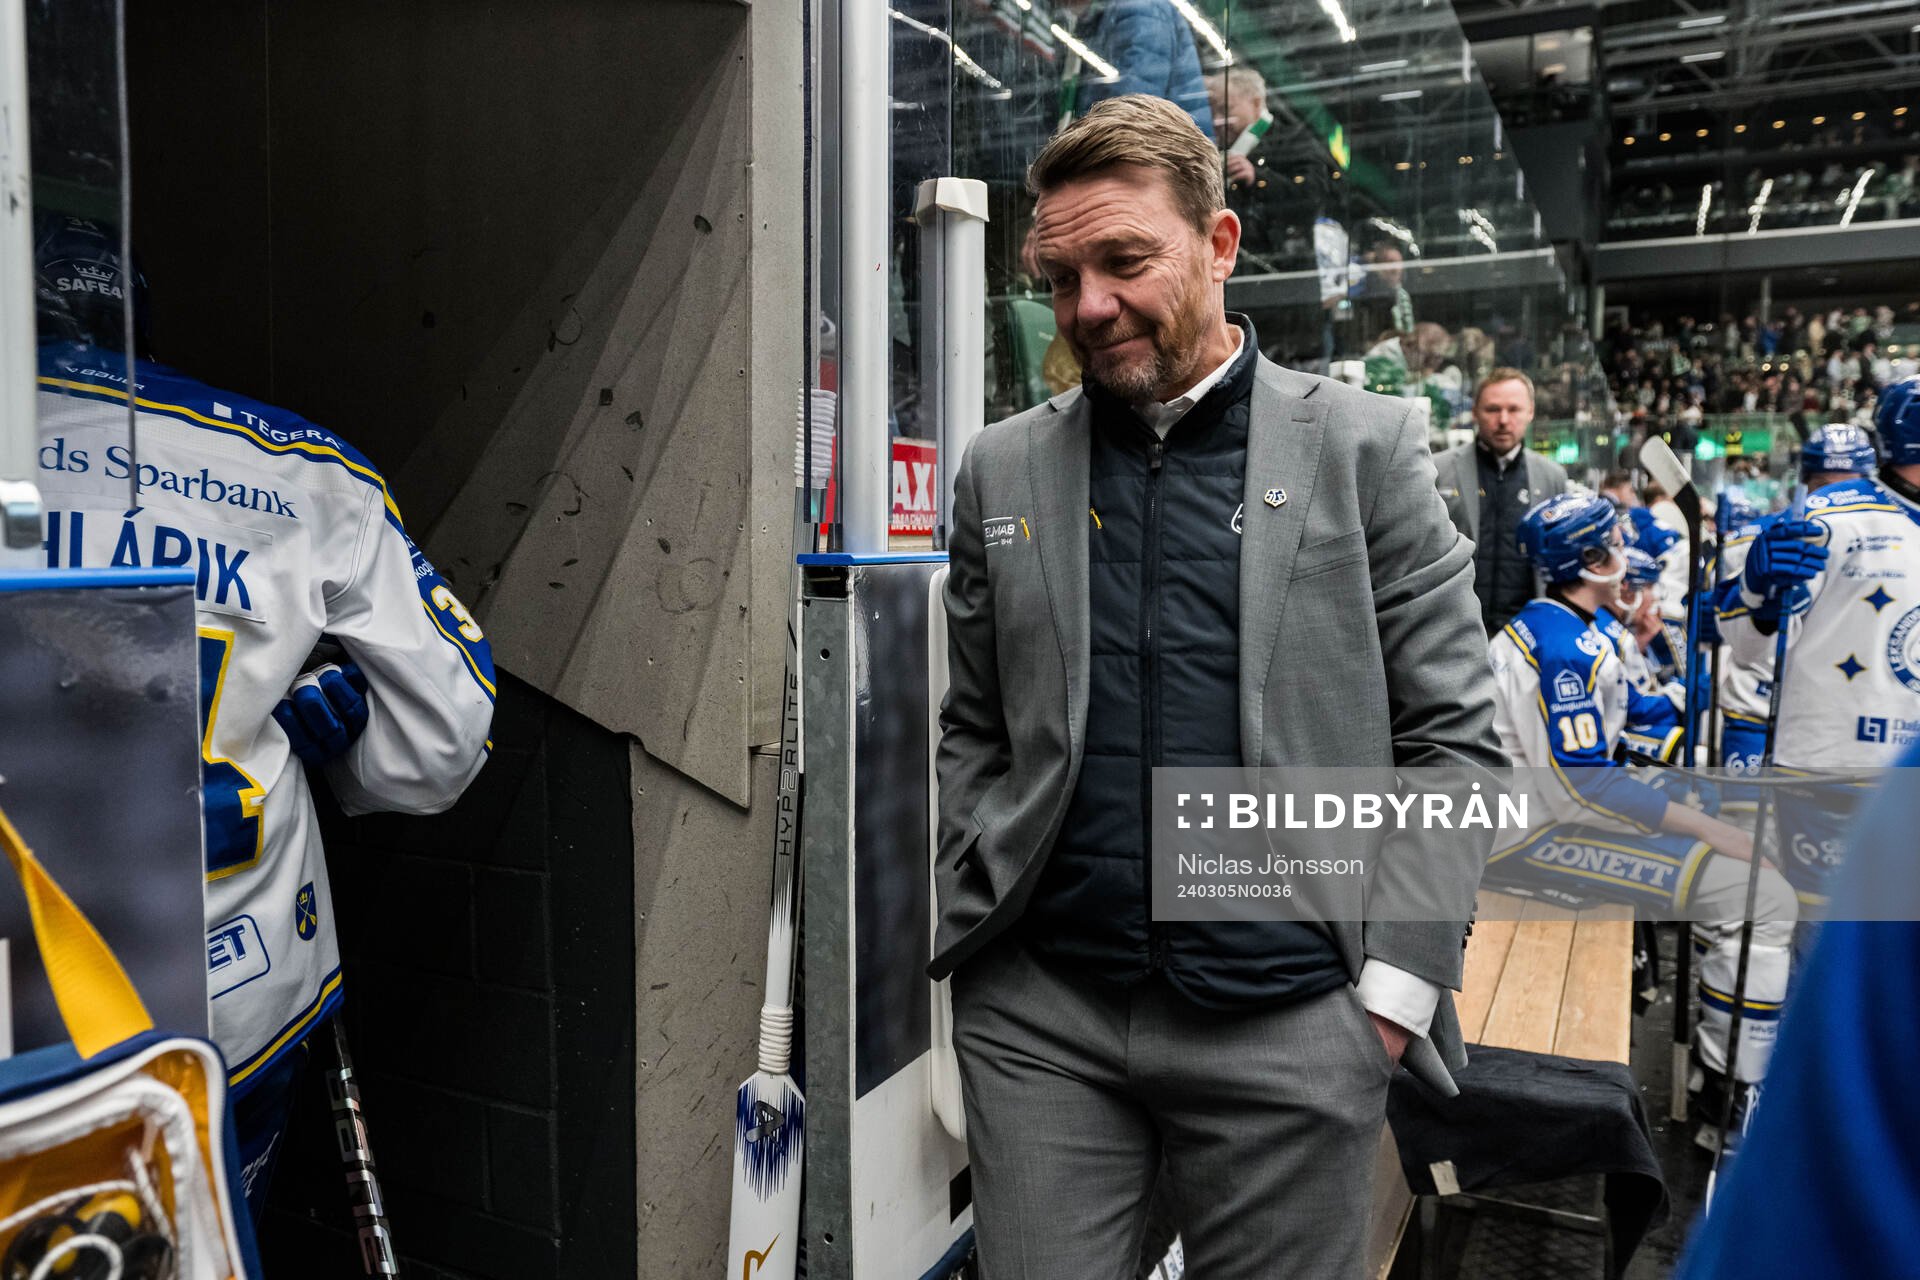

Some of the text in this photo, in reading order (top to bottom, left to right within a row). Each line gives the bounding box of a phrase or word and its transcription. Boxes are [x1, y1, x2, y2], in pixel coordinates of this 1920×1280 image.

[240, 411, 342, 450] TEGERA
[105, 446, 299, 519] Sparbank
[1558, 713, 1598, 752] 10
[1532, 842, 1673, 887] DONETT
